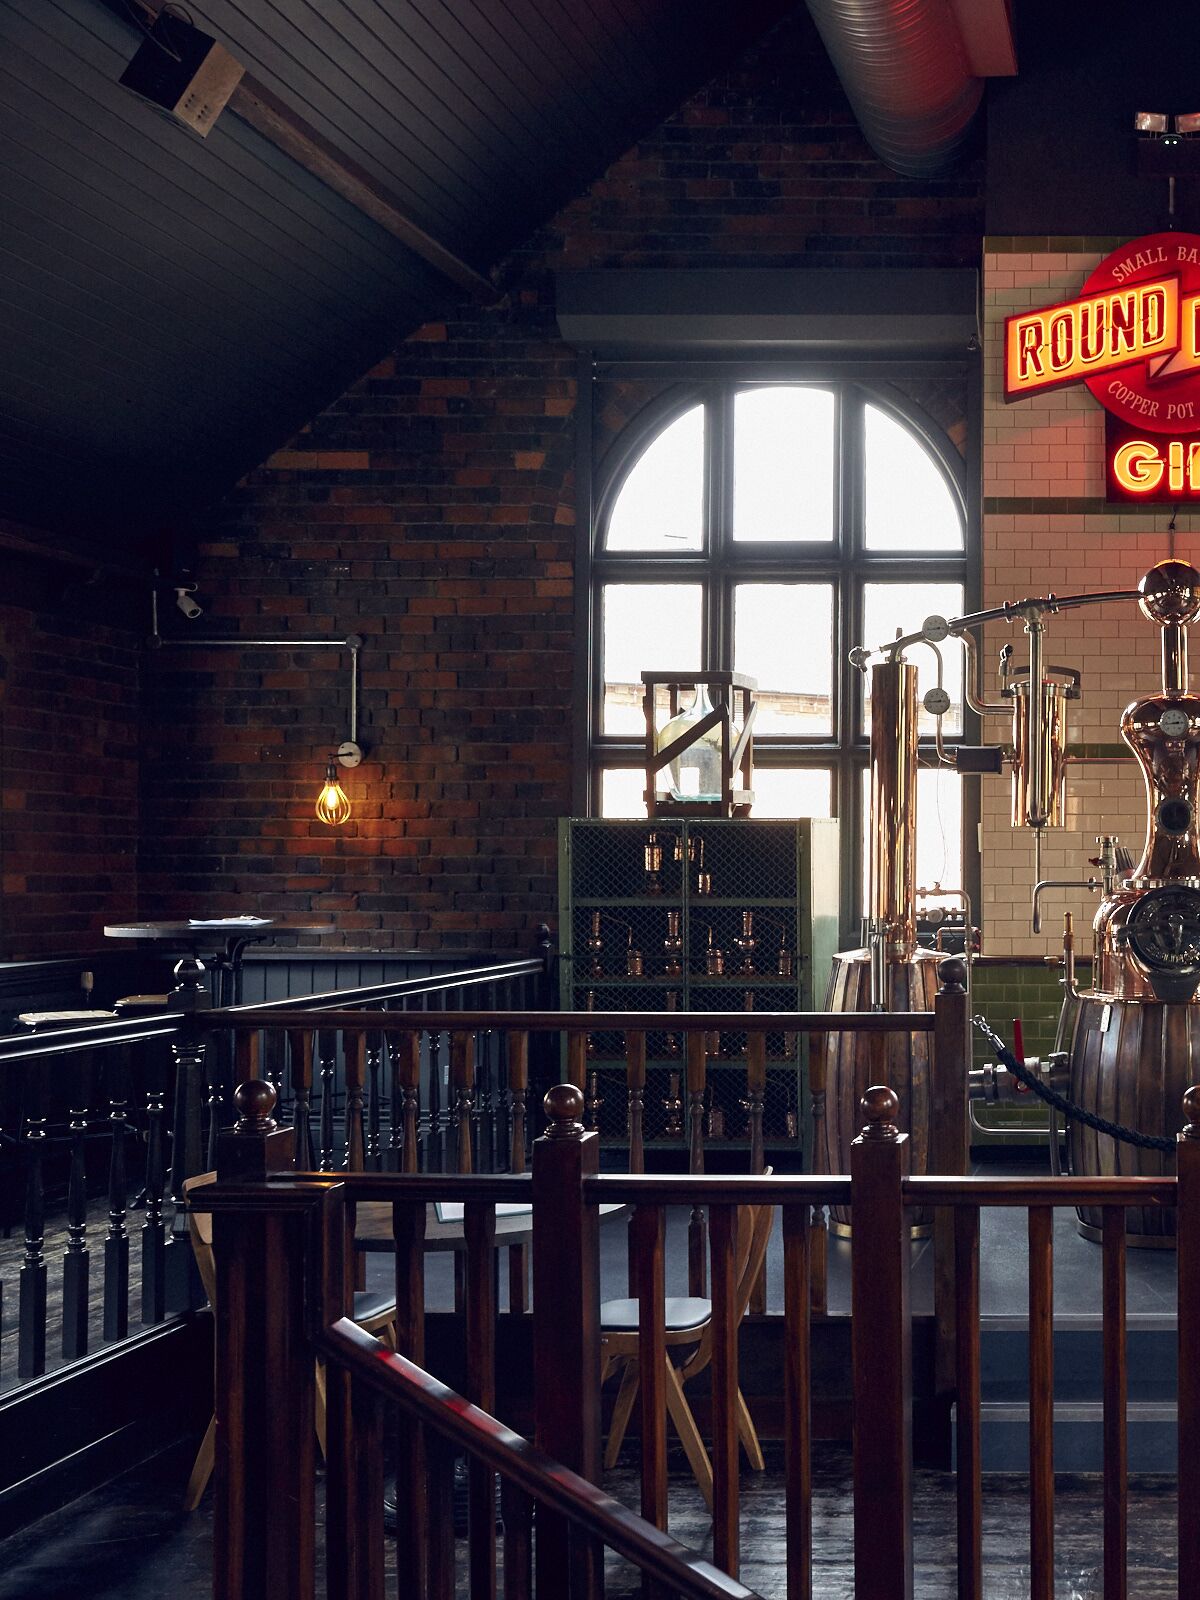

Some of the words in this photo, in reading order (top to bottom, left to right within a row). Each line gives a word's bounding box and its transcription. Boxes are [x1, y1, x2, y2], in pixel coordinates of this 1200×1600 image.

[1111, 246, 1168, 283] SMALL
[1017, 285, 1168, 380] ROUND
[1107, 379, 1159, 418] COPPER
[1167, 401, 1195, 420] POT
